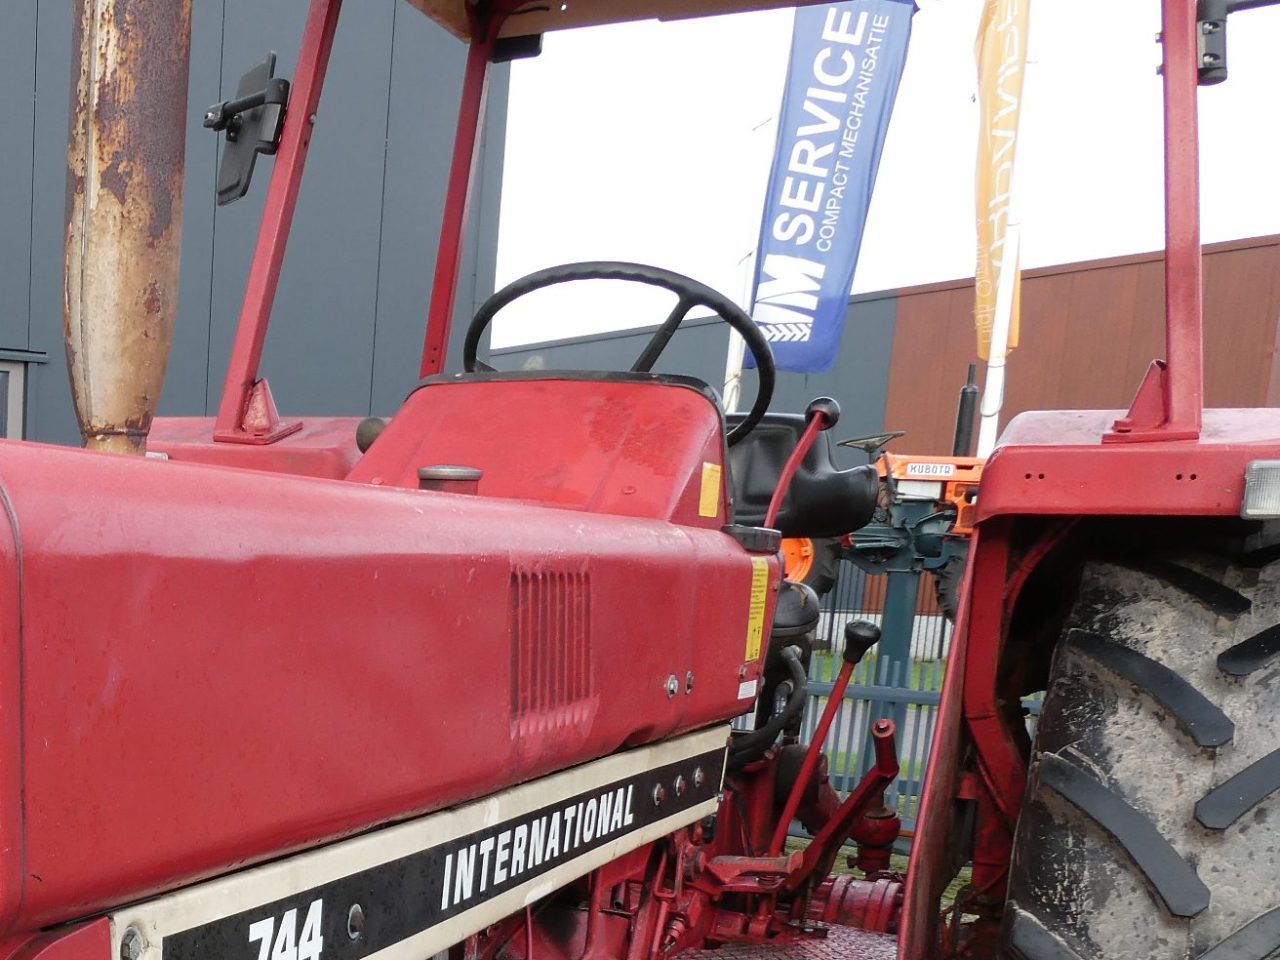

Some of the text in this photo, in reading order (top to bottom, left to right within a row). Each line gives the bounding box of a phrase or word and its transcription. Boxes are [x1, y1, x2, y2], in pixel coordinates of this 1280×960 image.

[772, 7, 869, 245] SERVICE
[816, 14, 890, 252] COMPACT MECHANISATIE
[910, 464, 951, 474] KUBOTA
[441, 784, 634, 911] INTERNATIONAL
